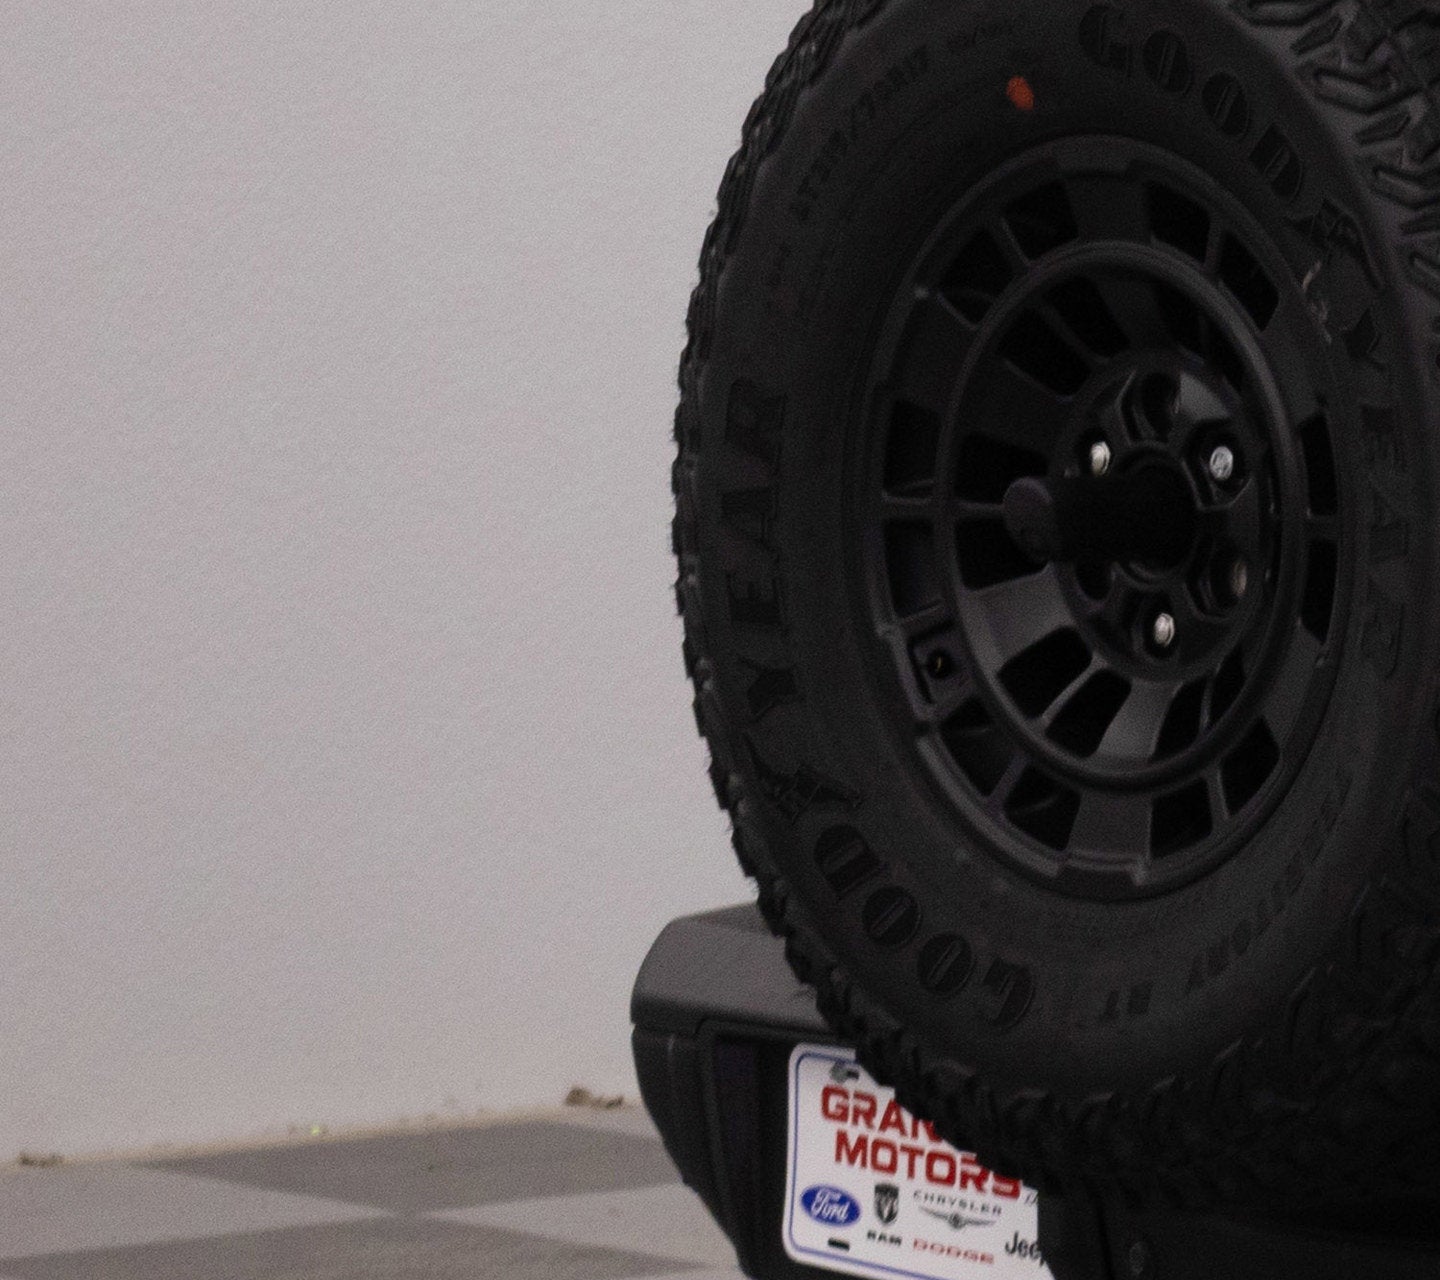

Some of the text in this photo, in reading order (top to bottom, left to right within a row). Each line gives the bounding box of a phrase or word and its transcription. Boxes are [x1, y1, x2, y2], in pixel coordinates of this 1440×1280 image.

[834, 1129, 1021, 1200] MOTORS
[912, 1190, 1003, 1216] CHRYSLER
[866, 1228, 902, 1246] RAM
[1004, 1231, 1043, 1267] Jee
[912, 1238, 995, 1265] DODGE
